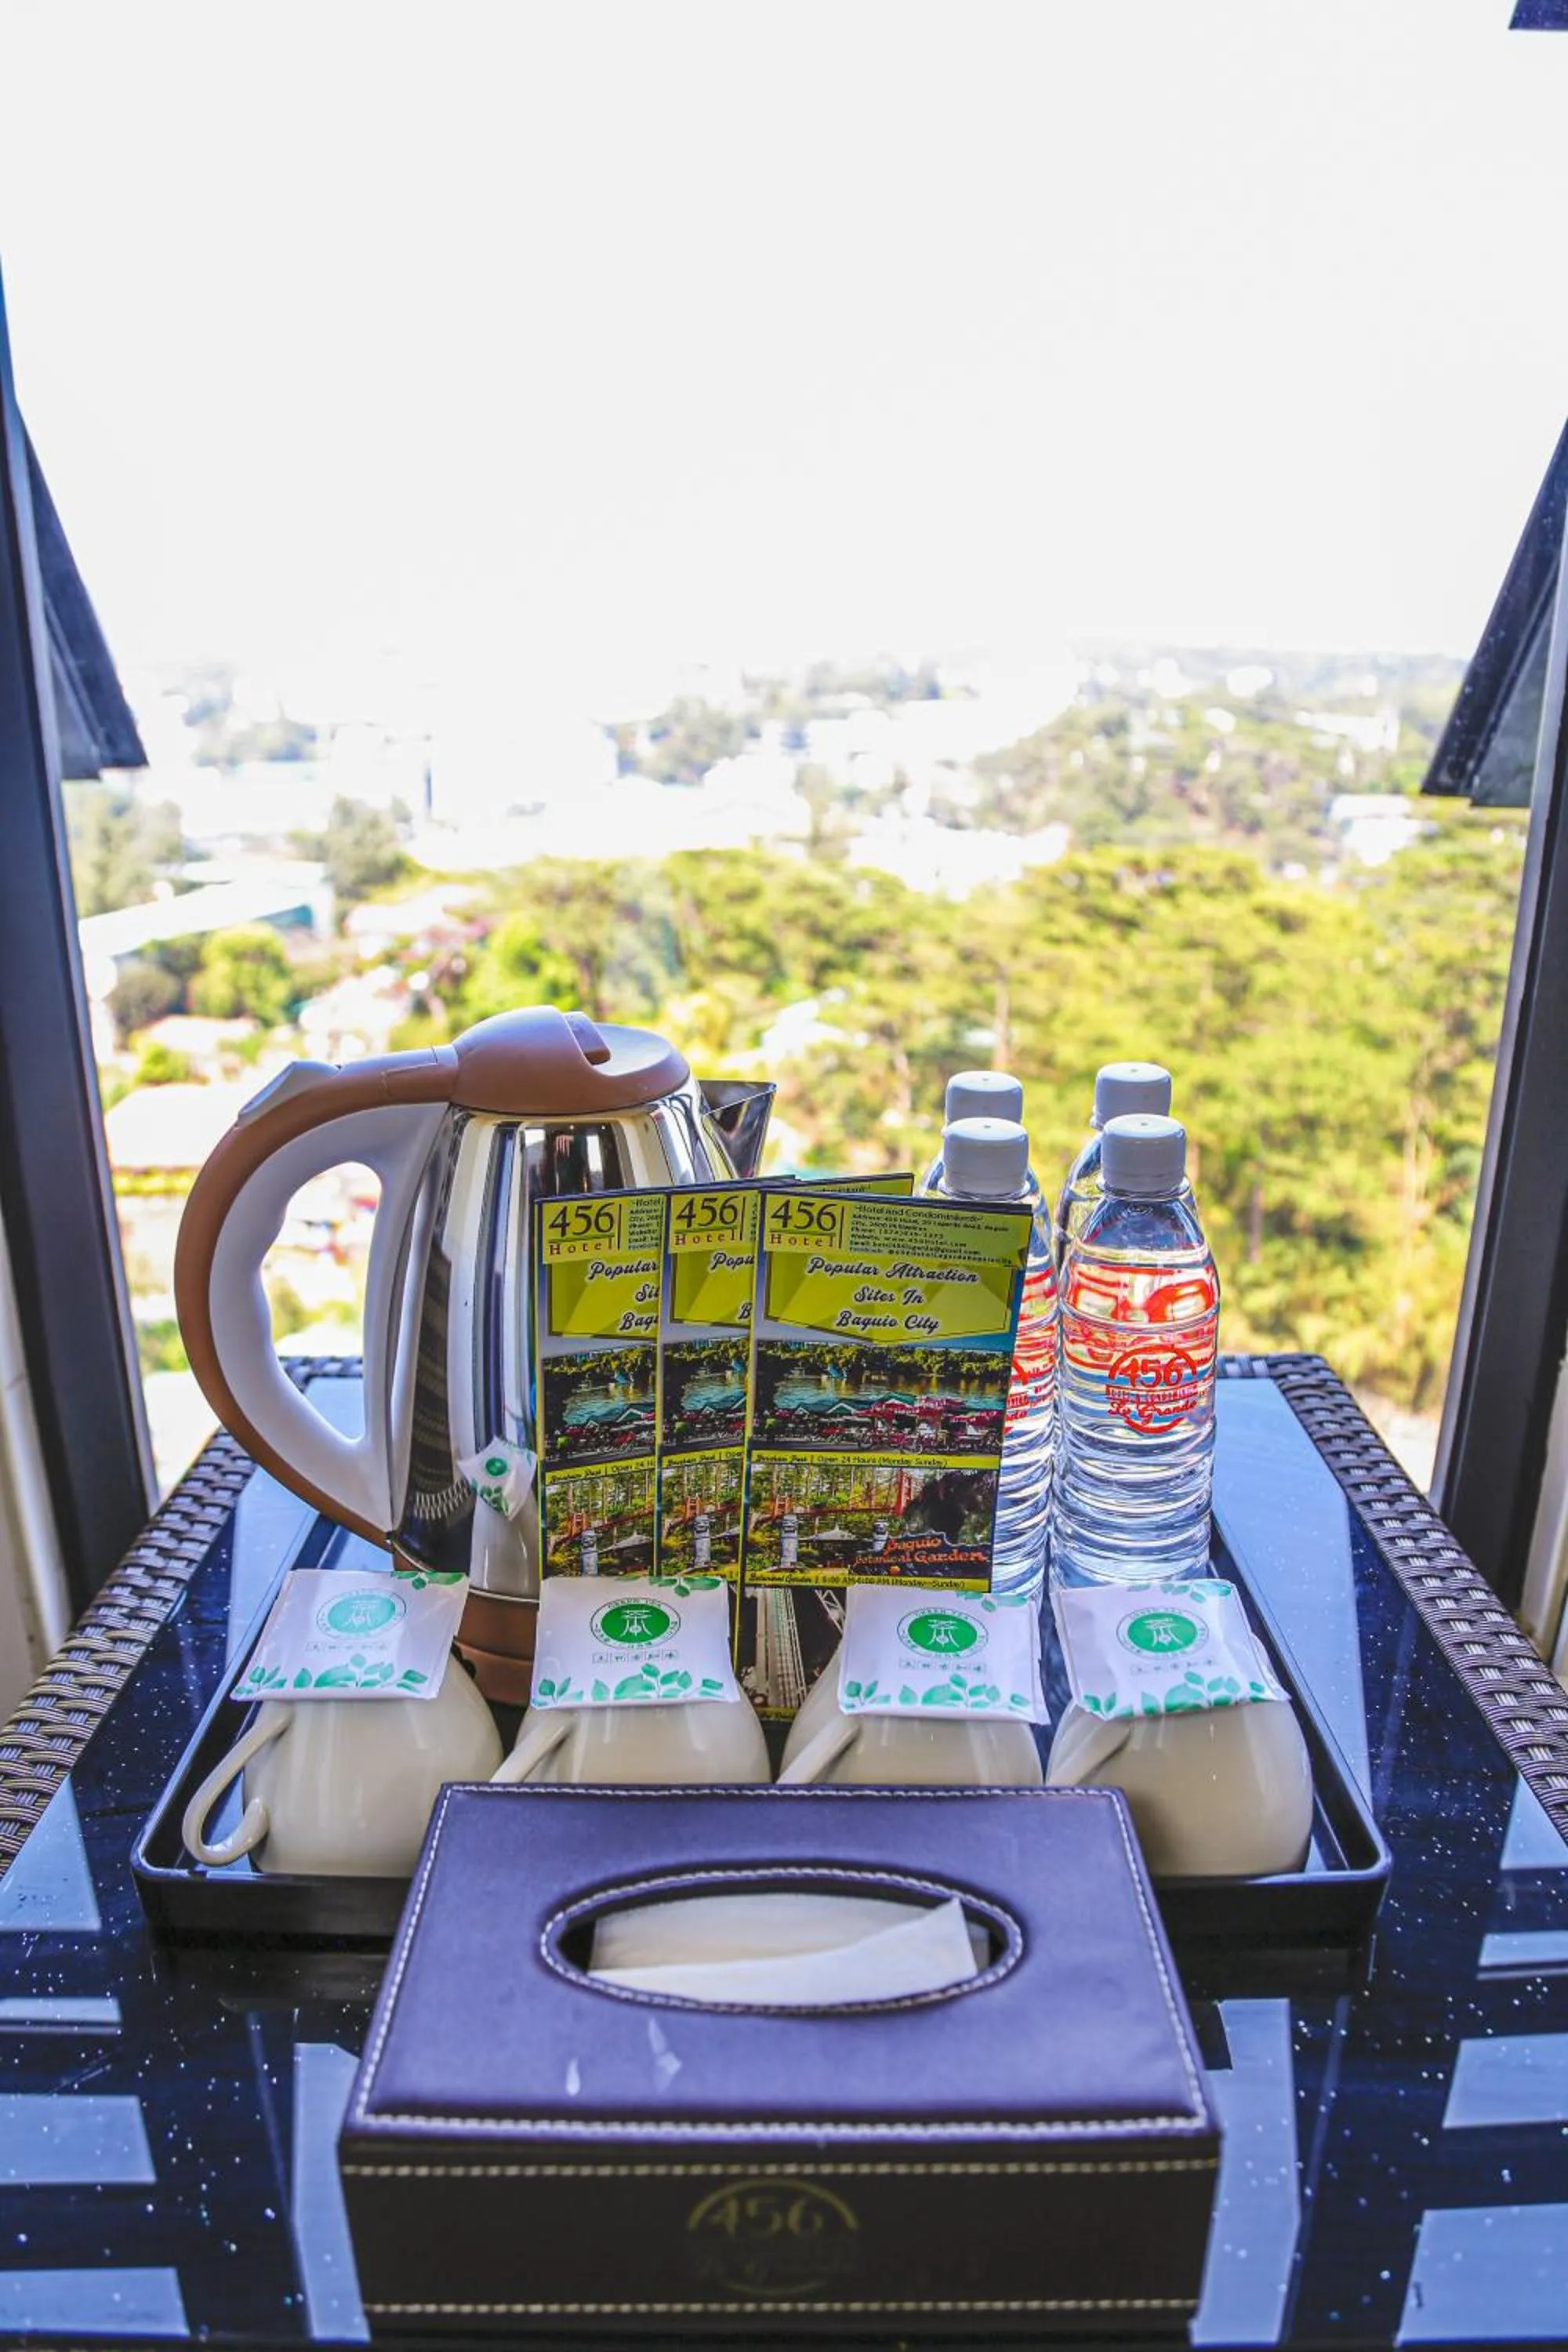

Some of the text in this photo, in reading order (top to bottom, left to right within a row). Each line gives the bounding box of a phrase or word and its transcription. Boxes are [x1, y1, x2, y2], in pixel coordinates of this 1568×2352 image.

[549, 1202, 615, 1237] 456
[676, 1196, 739, 1228] 456
[770, 1199, 837, 1232] 456
[549, 1236, 614, 1255] Hotel
[674, 1229, 736, 1246] Hotel
[769, 1234, 834, 1248] Hotel
[588, 1260, 657, 1279] Popular
[807, 1256, 978, 1283] Popular Attraction
[854, 1286, 924, 1305] Sites In
[835, 1310, 940, 1334] Baguio City
[1118, 1357, 1183, 1388] 456
[884, 1537, 942, 1555] Baguio
[913, 1549, 990, 1565] Garden
[707, 2196, 825, 2238] 456
